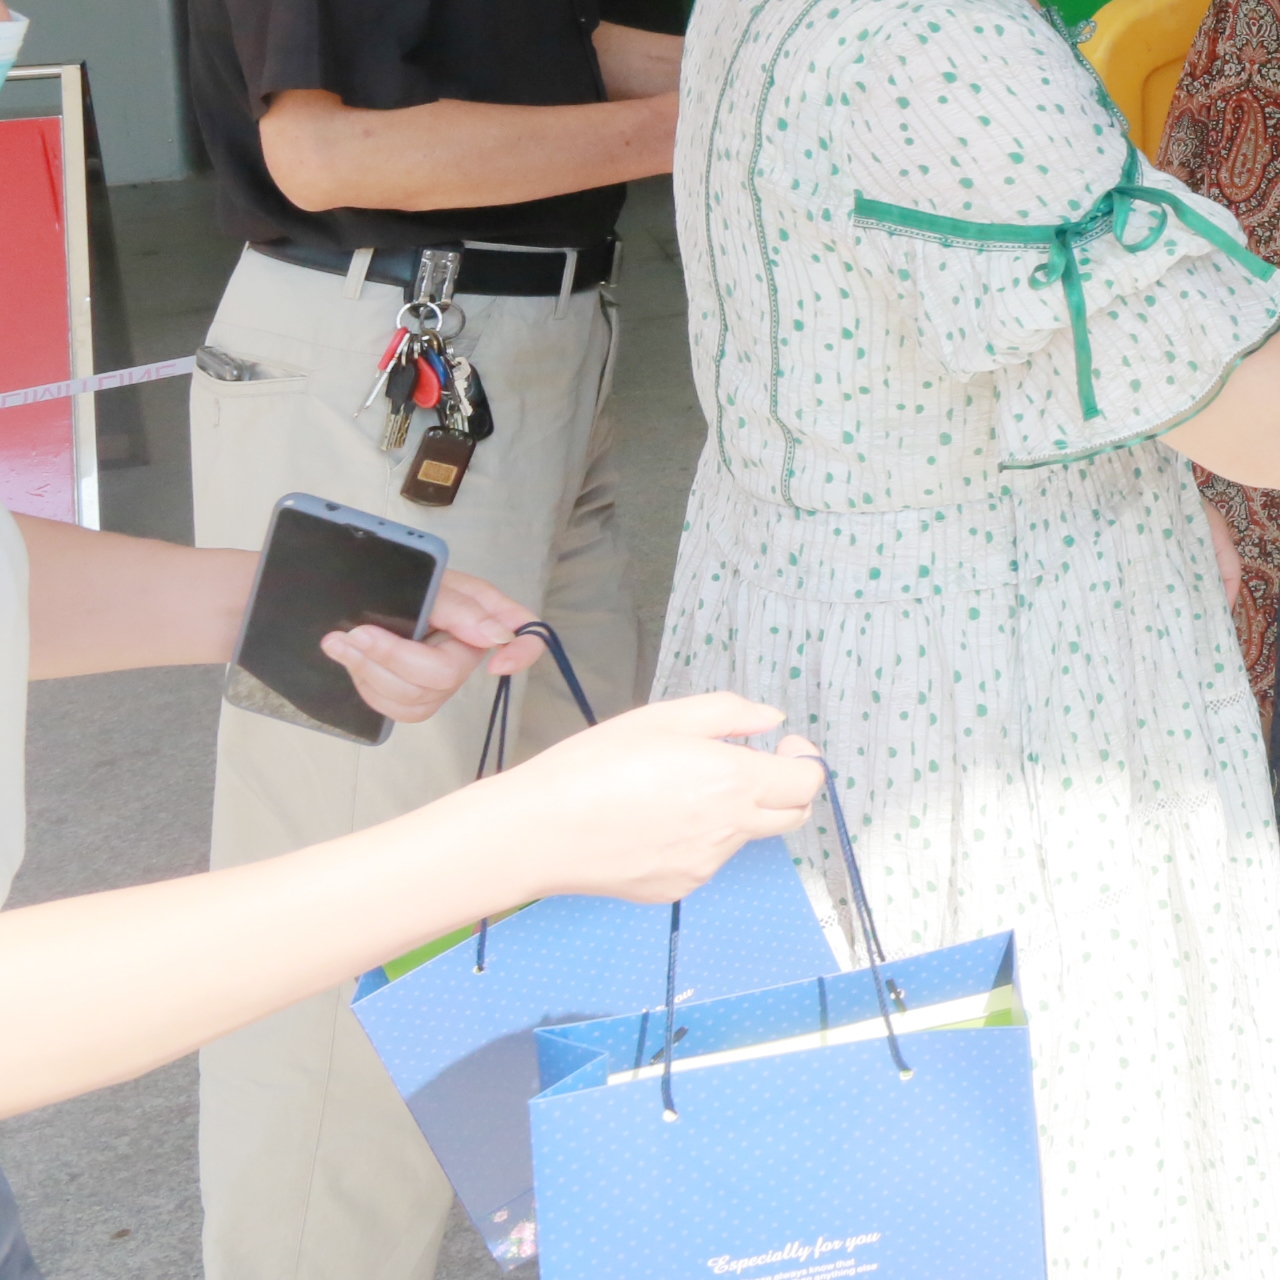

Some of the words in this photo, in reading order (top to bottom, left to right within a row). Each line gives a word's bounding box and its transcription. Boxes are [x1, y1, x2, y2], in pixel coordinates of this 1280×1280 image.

[706, 1240, 813, 1274] Especially
[813, 1236, 844, 1259] for
[845, 1231, 882, 1253] you
[808, 1263, 835, 1274] know
[835, 1258, 855, 1269] that
[856, 1262, 878, 1272] else
